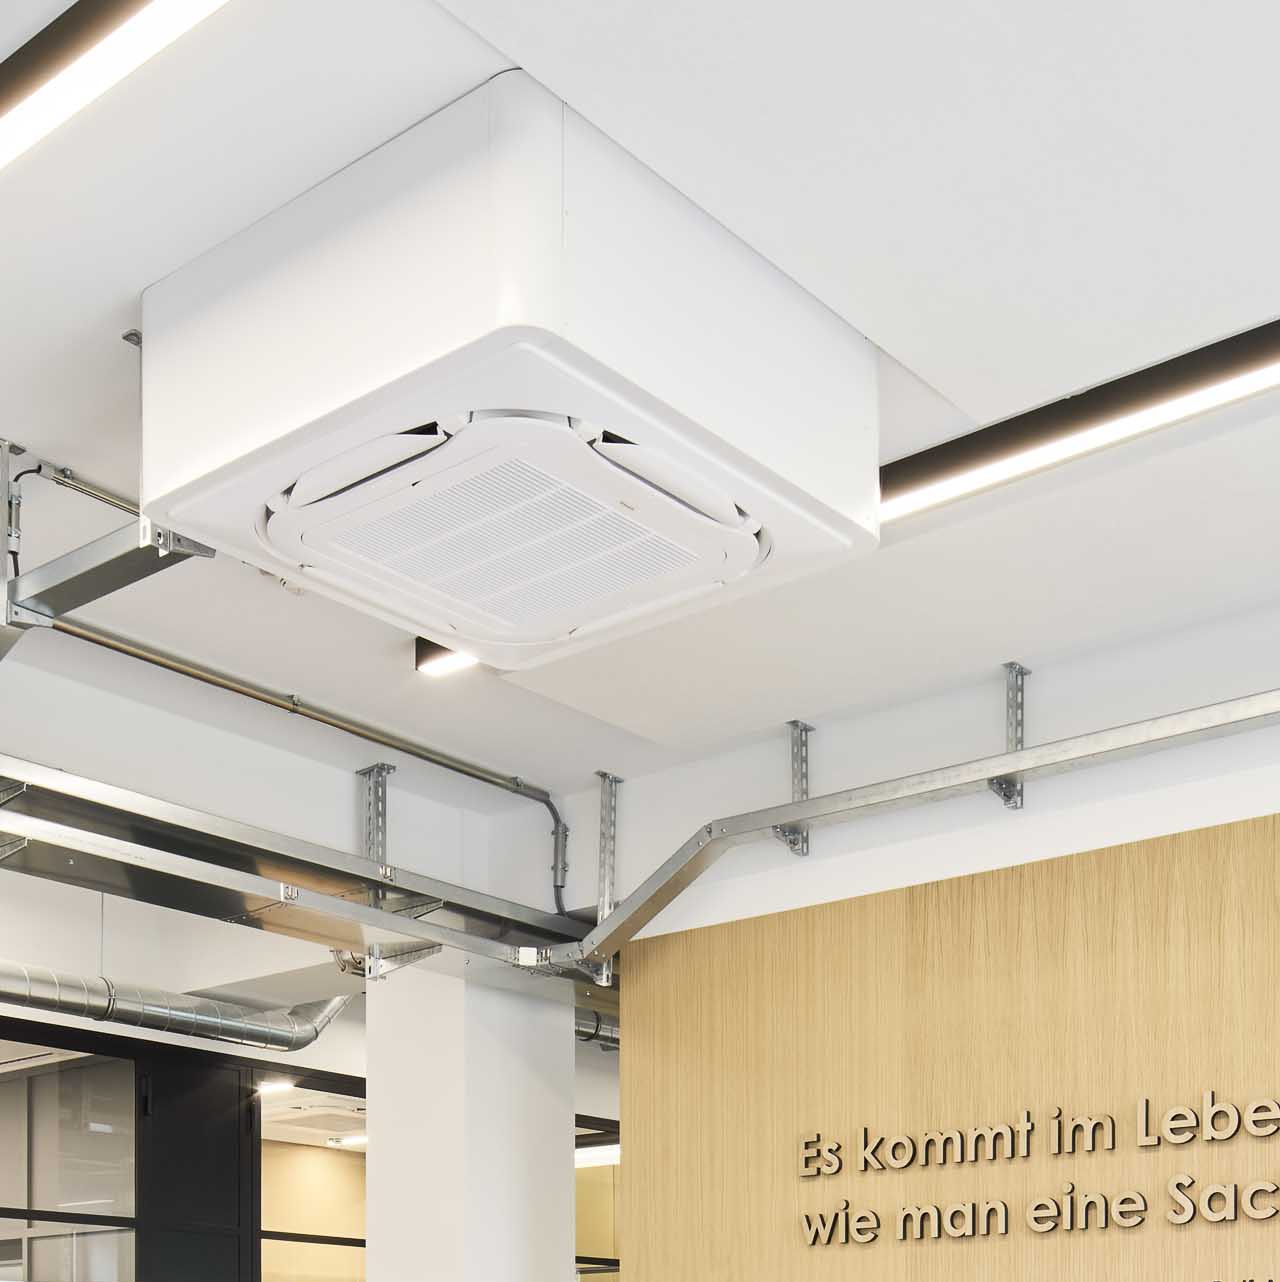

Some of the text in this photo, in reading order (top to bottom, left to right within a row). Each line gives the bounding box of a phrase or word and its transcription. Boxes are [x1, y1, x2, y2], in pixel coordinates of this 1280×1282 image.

[799, 1133, 841, 1177] Es
[857, 1110, 1035, 1172] kommt
[1049, 1106, 1115, 1155] im
[800, 1199, 880, 1246] wie
[895, 1195, 1008, 1240] man
[1026, 1182, 1146, 1233] eine
